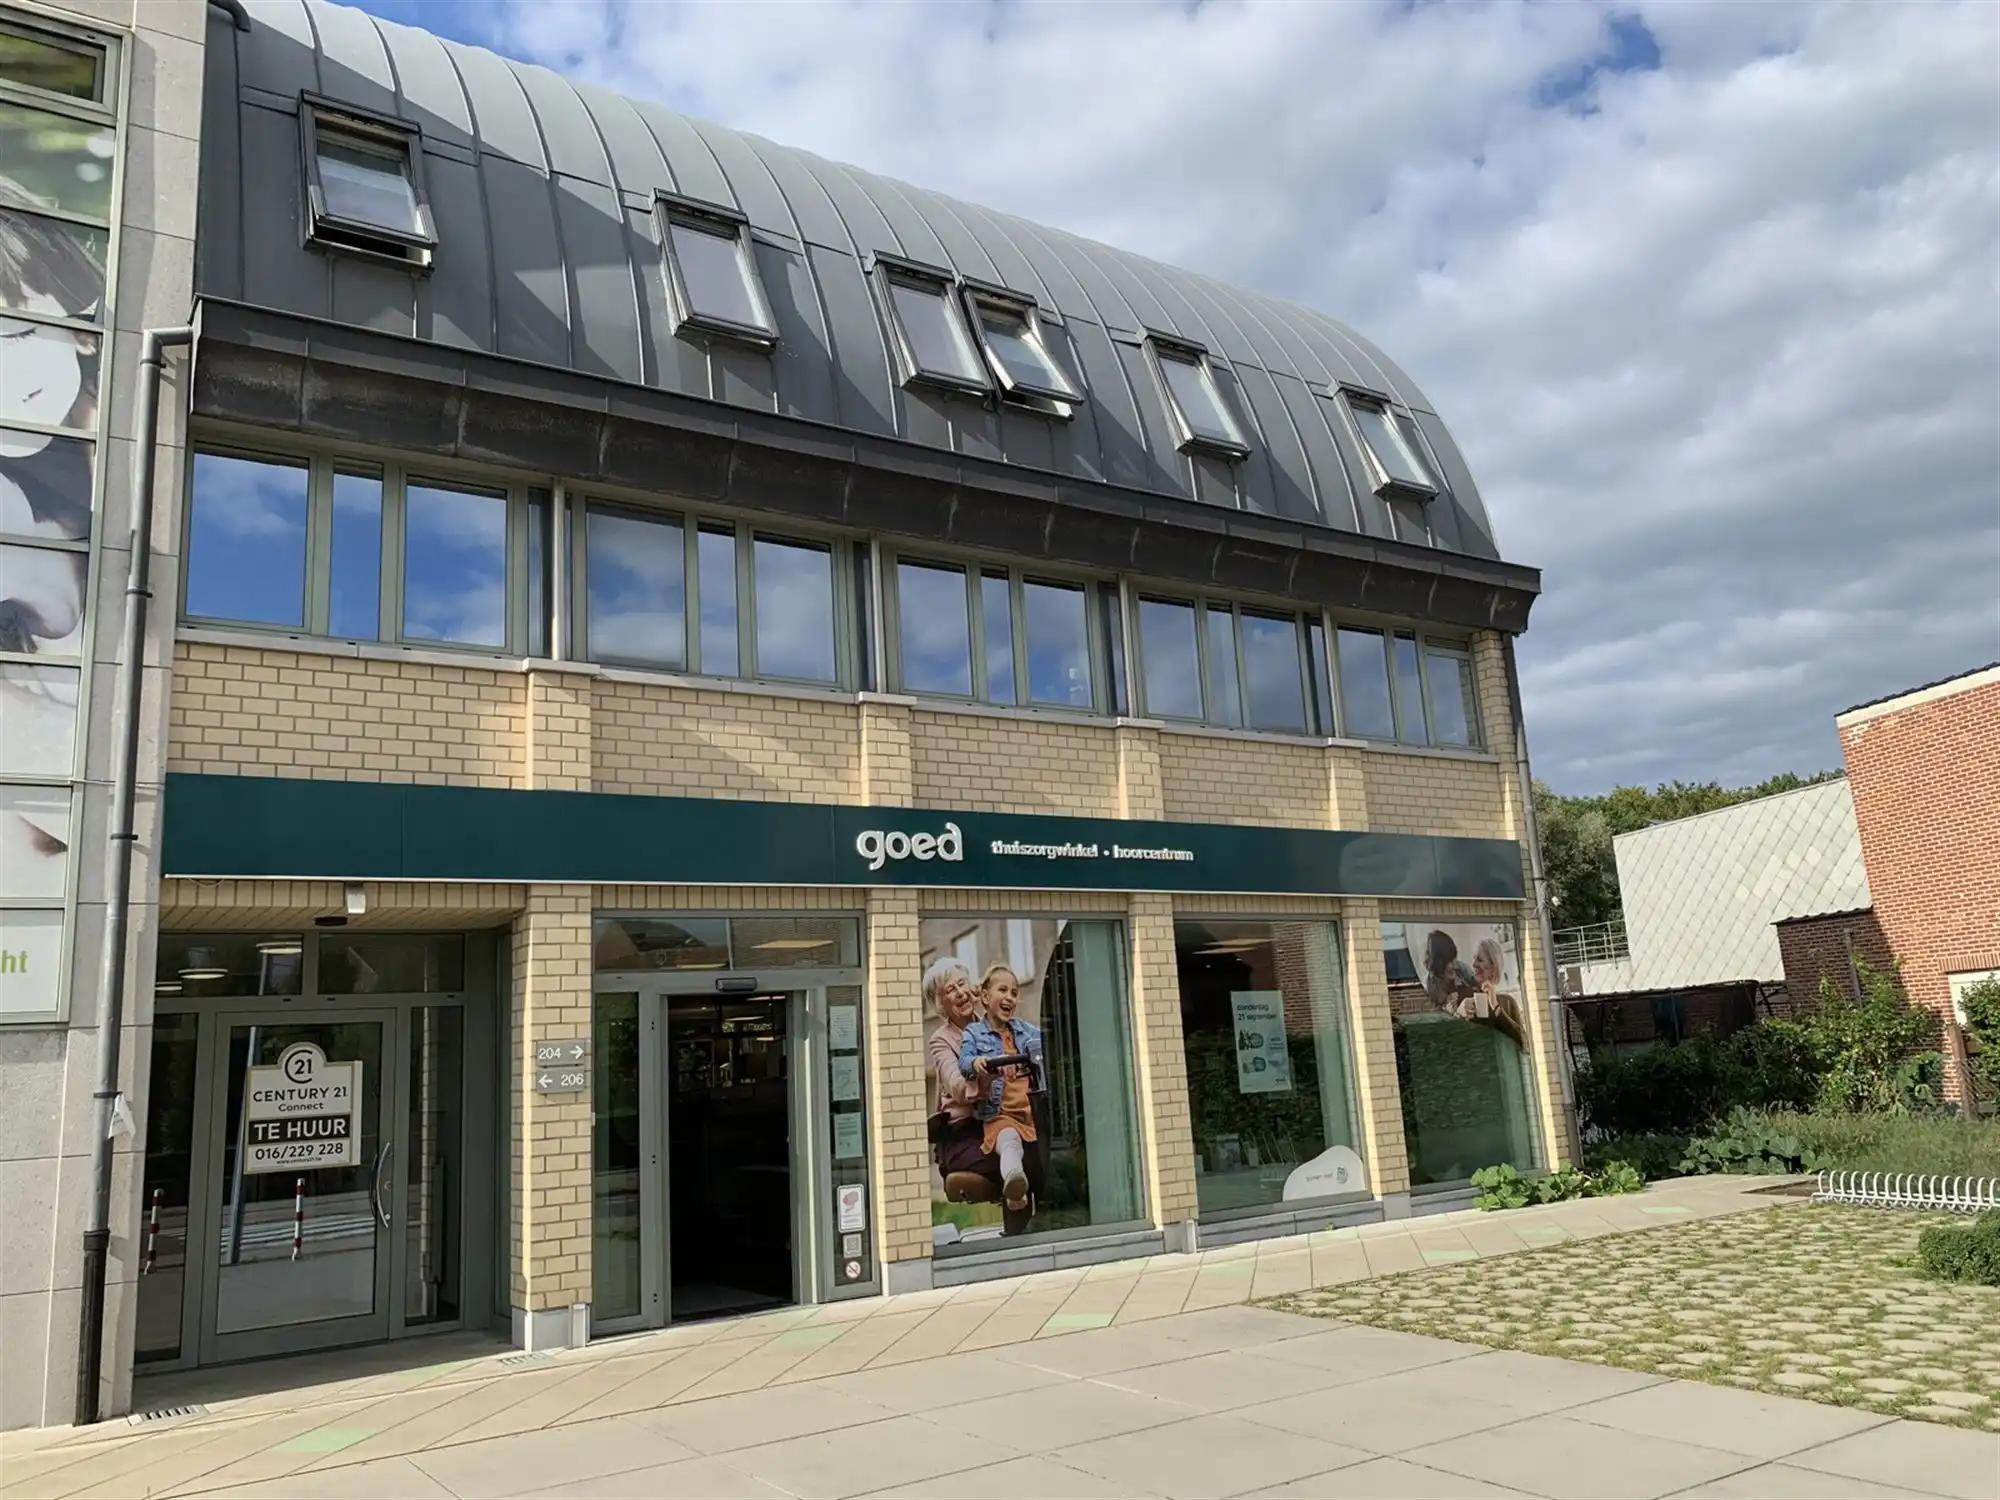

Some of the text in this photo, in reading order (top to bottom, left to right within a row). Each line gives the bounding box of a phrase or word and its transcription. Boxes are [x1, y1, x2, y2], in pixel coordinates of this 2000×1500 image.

[857, 822, 963, 870] goed
[991, 840, 1194, 861] thuiszorgwinkel hoorcentrum
[538, 1047, 561, 1059] 204
[294, 1058, 313, 1075] 21
[560, 1073, 584, 1086] 206
[253, 1086, 347, 1102] CENTURY 21
[278, 1102, 324, 1112] Connect
[253, 1118, 346, 1141] TE HUUR
[255, 1143, 344, 1160] 016/229 228
